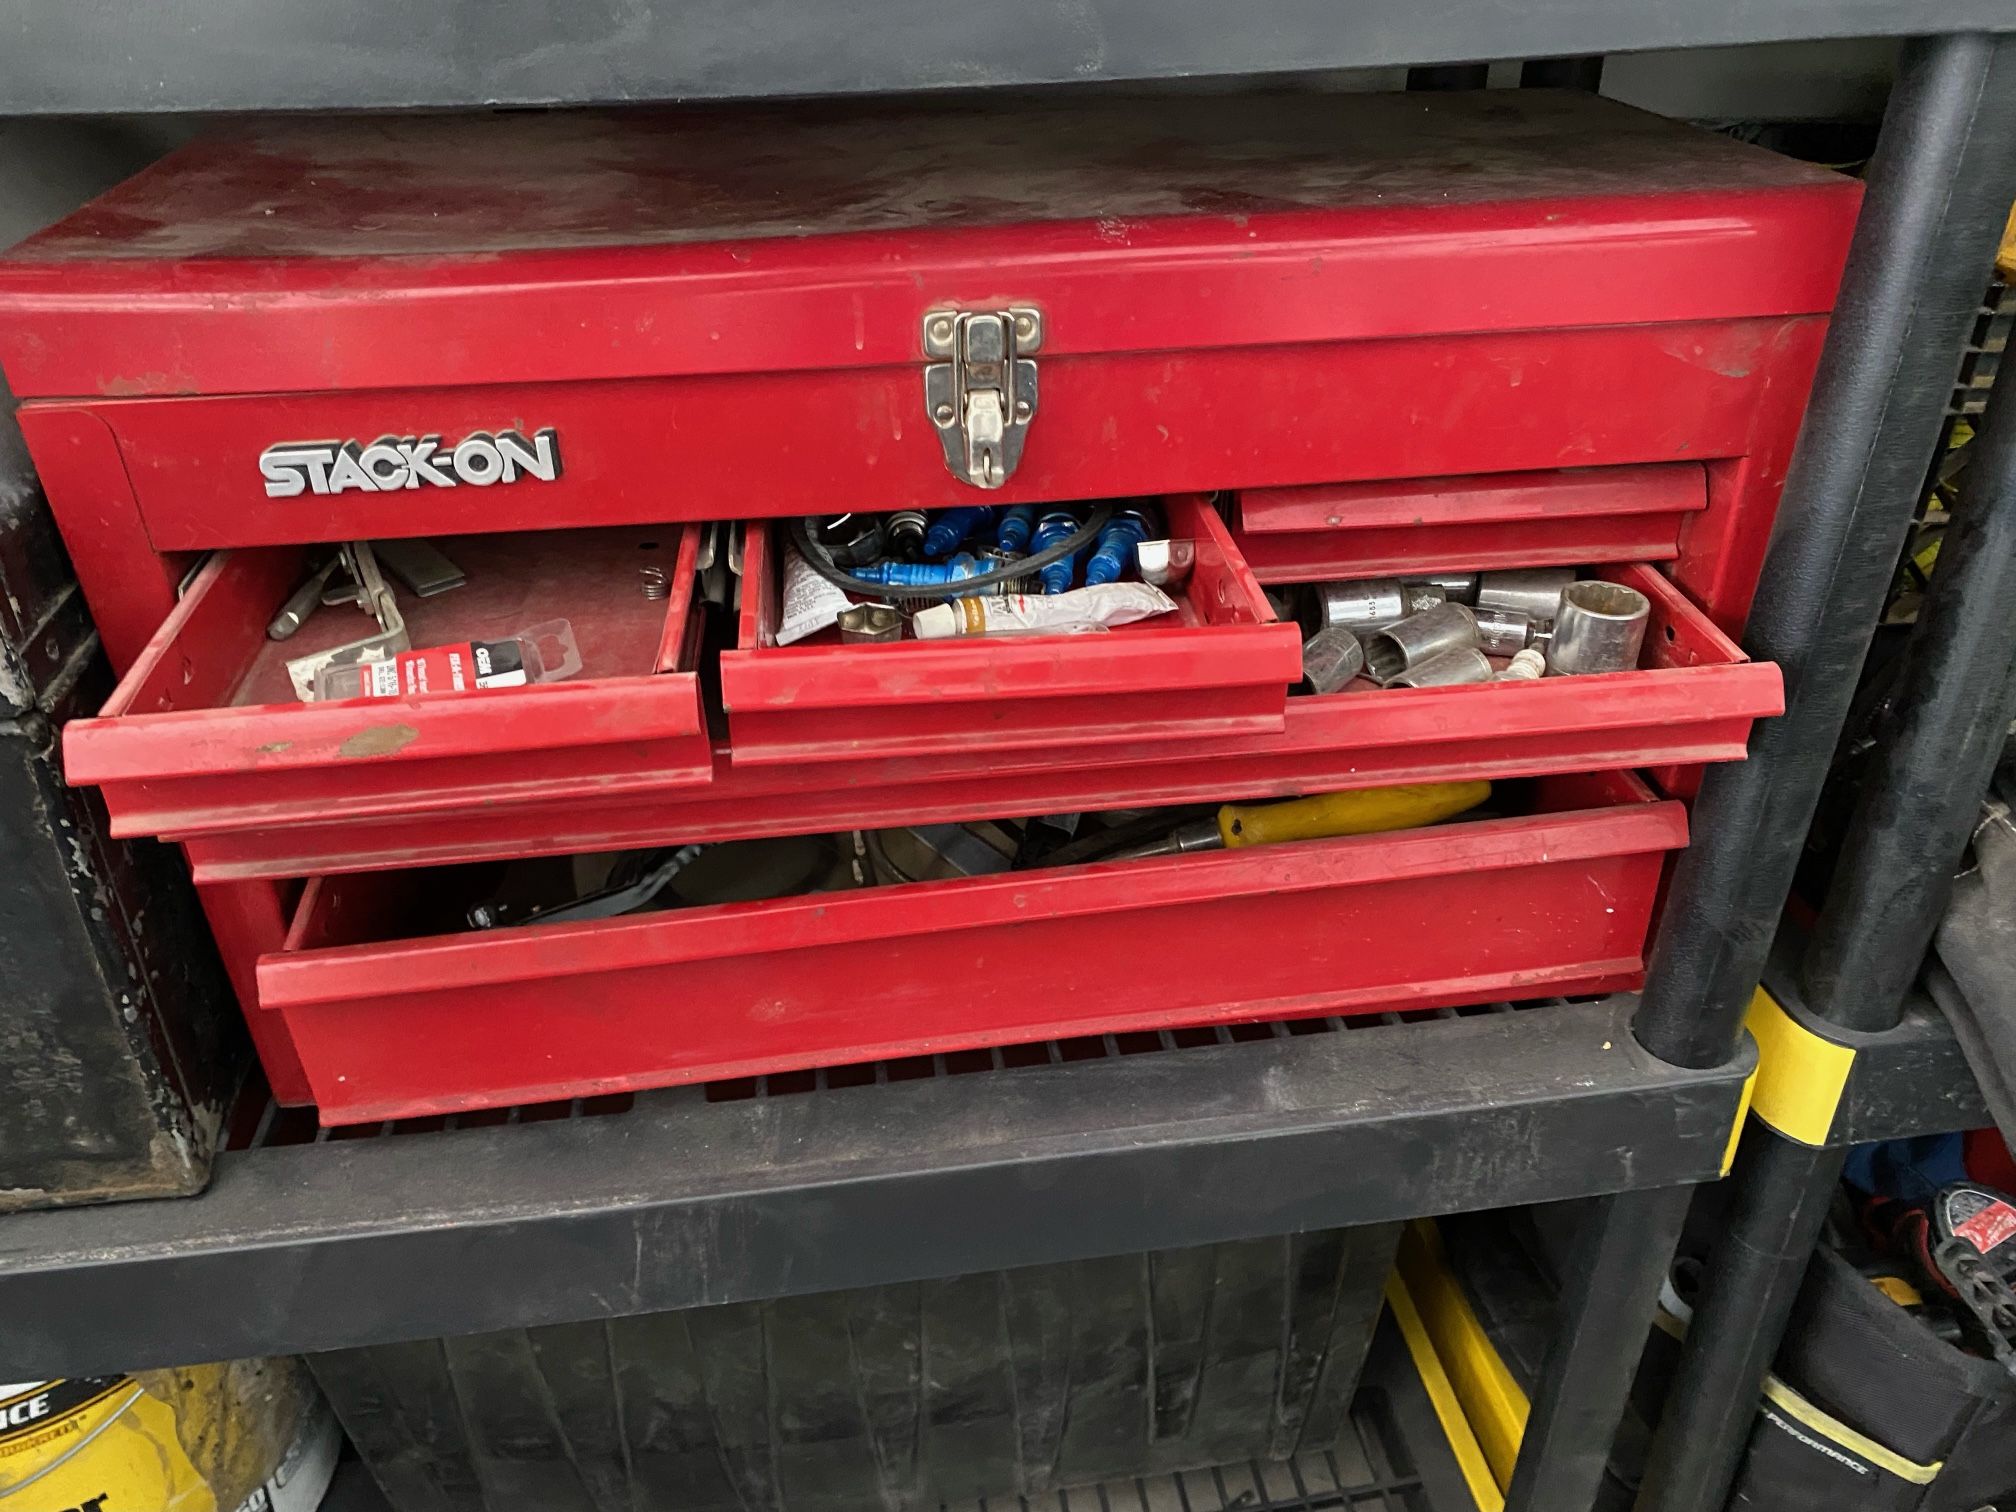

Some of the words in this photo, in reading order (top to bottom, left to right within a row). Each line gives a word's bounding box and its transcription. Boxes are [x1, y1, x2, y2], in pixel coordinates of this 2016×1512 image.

[258, 427, 562, 498] STACK-ON
[475, 648, 493, 675] OEM
[1767, 1412, 1869, 1475] PERFORMANCE
